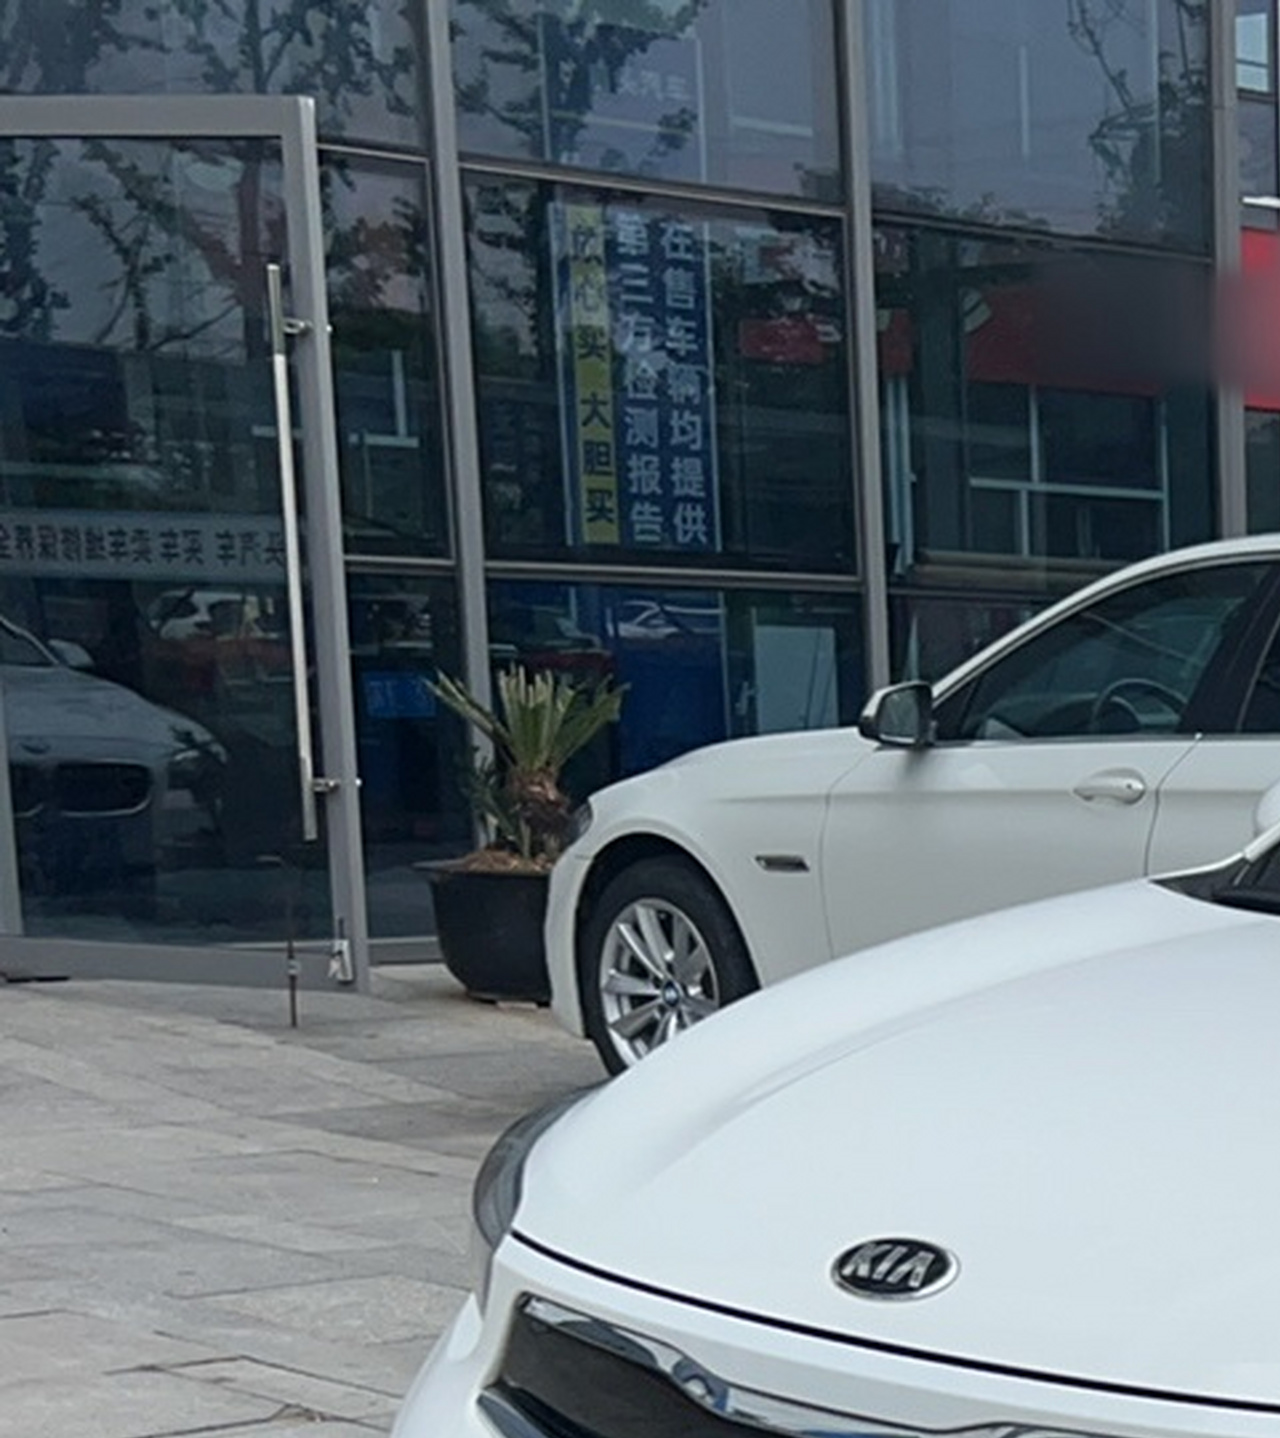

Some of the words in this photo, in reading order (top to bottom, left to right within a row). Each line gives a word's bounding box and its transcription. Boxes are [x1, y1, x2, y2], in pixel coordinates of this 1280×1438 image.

[580, 393, 616, 525] 大胆买
[614, 212, 666, 544] 第三方检测报告
[659, 219, 708, 545] 在售车辆均提供
[840, 1241, 936, 1289] KIA
